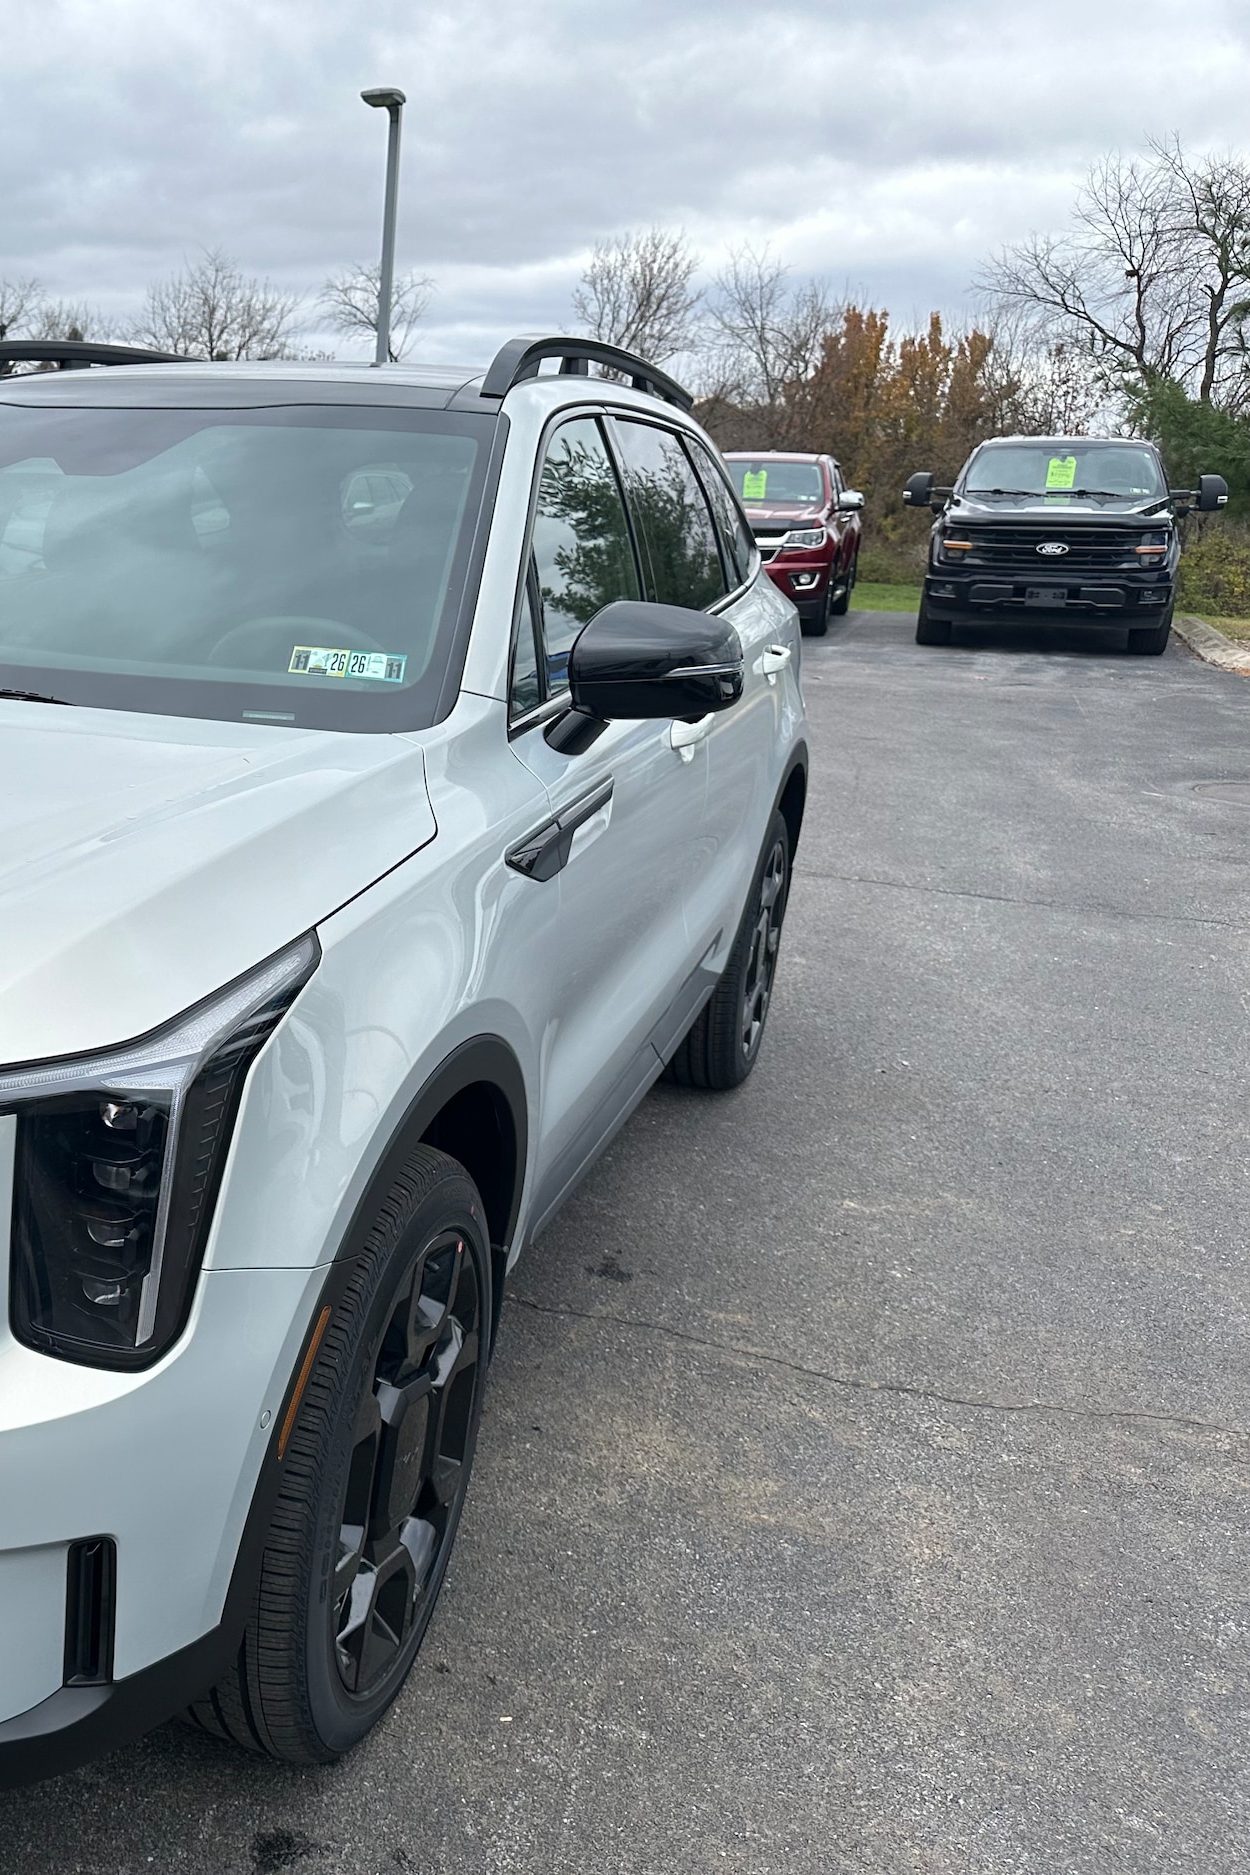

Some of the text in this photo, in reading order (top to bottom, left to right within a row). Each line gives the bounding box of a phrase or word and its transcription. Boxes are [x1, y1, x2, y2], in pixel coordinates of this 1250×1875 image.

[292, 653, 309, 671] 11
[330, 653, 347, 671] 26
[351, 655, 367, 674] 26
[386, 661, 402, 680] 11
